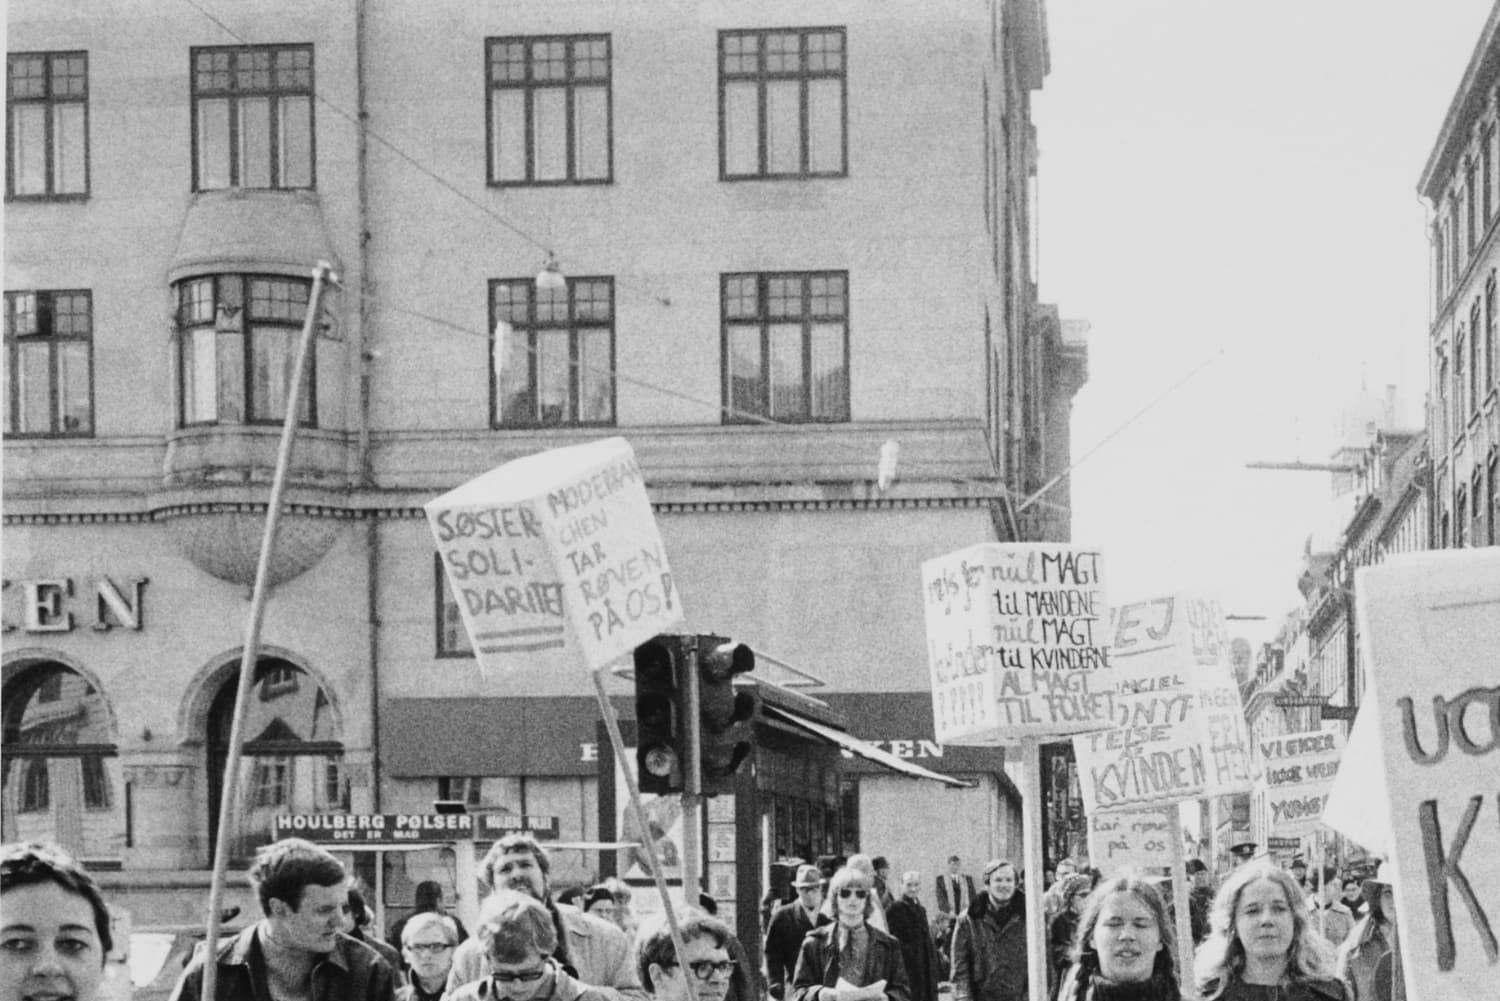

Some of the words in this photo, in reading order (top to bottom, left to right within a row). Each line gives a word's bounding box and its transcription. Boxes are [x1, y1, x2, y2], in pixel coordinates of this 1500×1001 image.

[566, 542, 606, 576] TAR
[579, 544, 662, 605] RØVEN
[1041, 552, 1100, 584] MAGT
[2, 577, 149, 632] EN
[992, 589, 1022, 616] til
[588, 599, 625, 640] PÅ
[1041, 618, 1100, 646] MAGT
[997, 646, 1024, 668] til
[1000, 671, 1032, 696] AL
[1032, 671, 1094, 694] MAGT
[997, 697, 1041, 723] TIL
[1042, 691, 1115, 722] FOLKET
[1091, 744, 1206, 800] KVINDEN
[278, 815, 385, 829] HOULBERG
[396, 815, 473, 829] PØLSER
[334, 830, 355, 839] DET
[367, 830, 382, 839] ER
